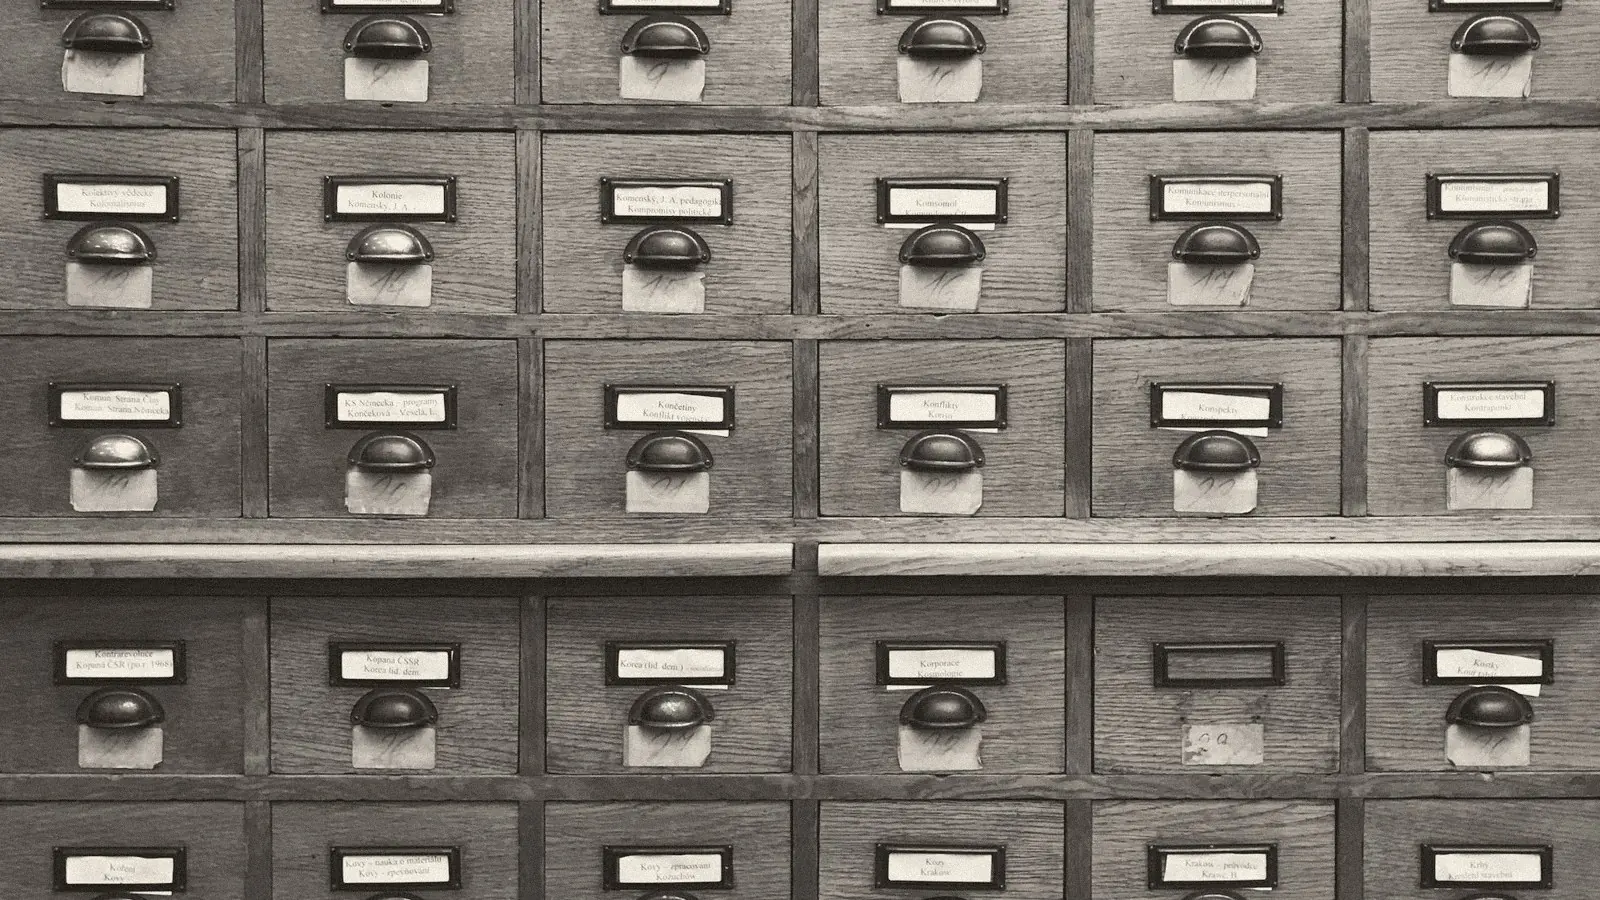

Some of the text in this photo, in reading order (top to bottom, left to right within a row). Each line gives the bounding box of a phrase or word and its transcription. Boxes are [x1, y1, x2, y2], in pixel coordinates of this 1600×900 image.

[372, 191, 402, 200] Kolonie
[658, 400, 697, 412] Končetiny
[620, 660, 643, 669] Korea
[920, 660, 960, 668] Korporace
[364, 665, 386, 674] Korea
